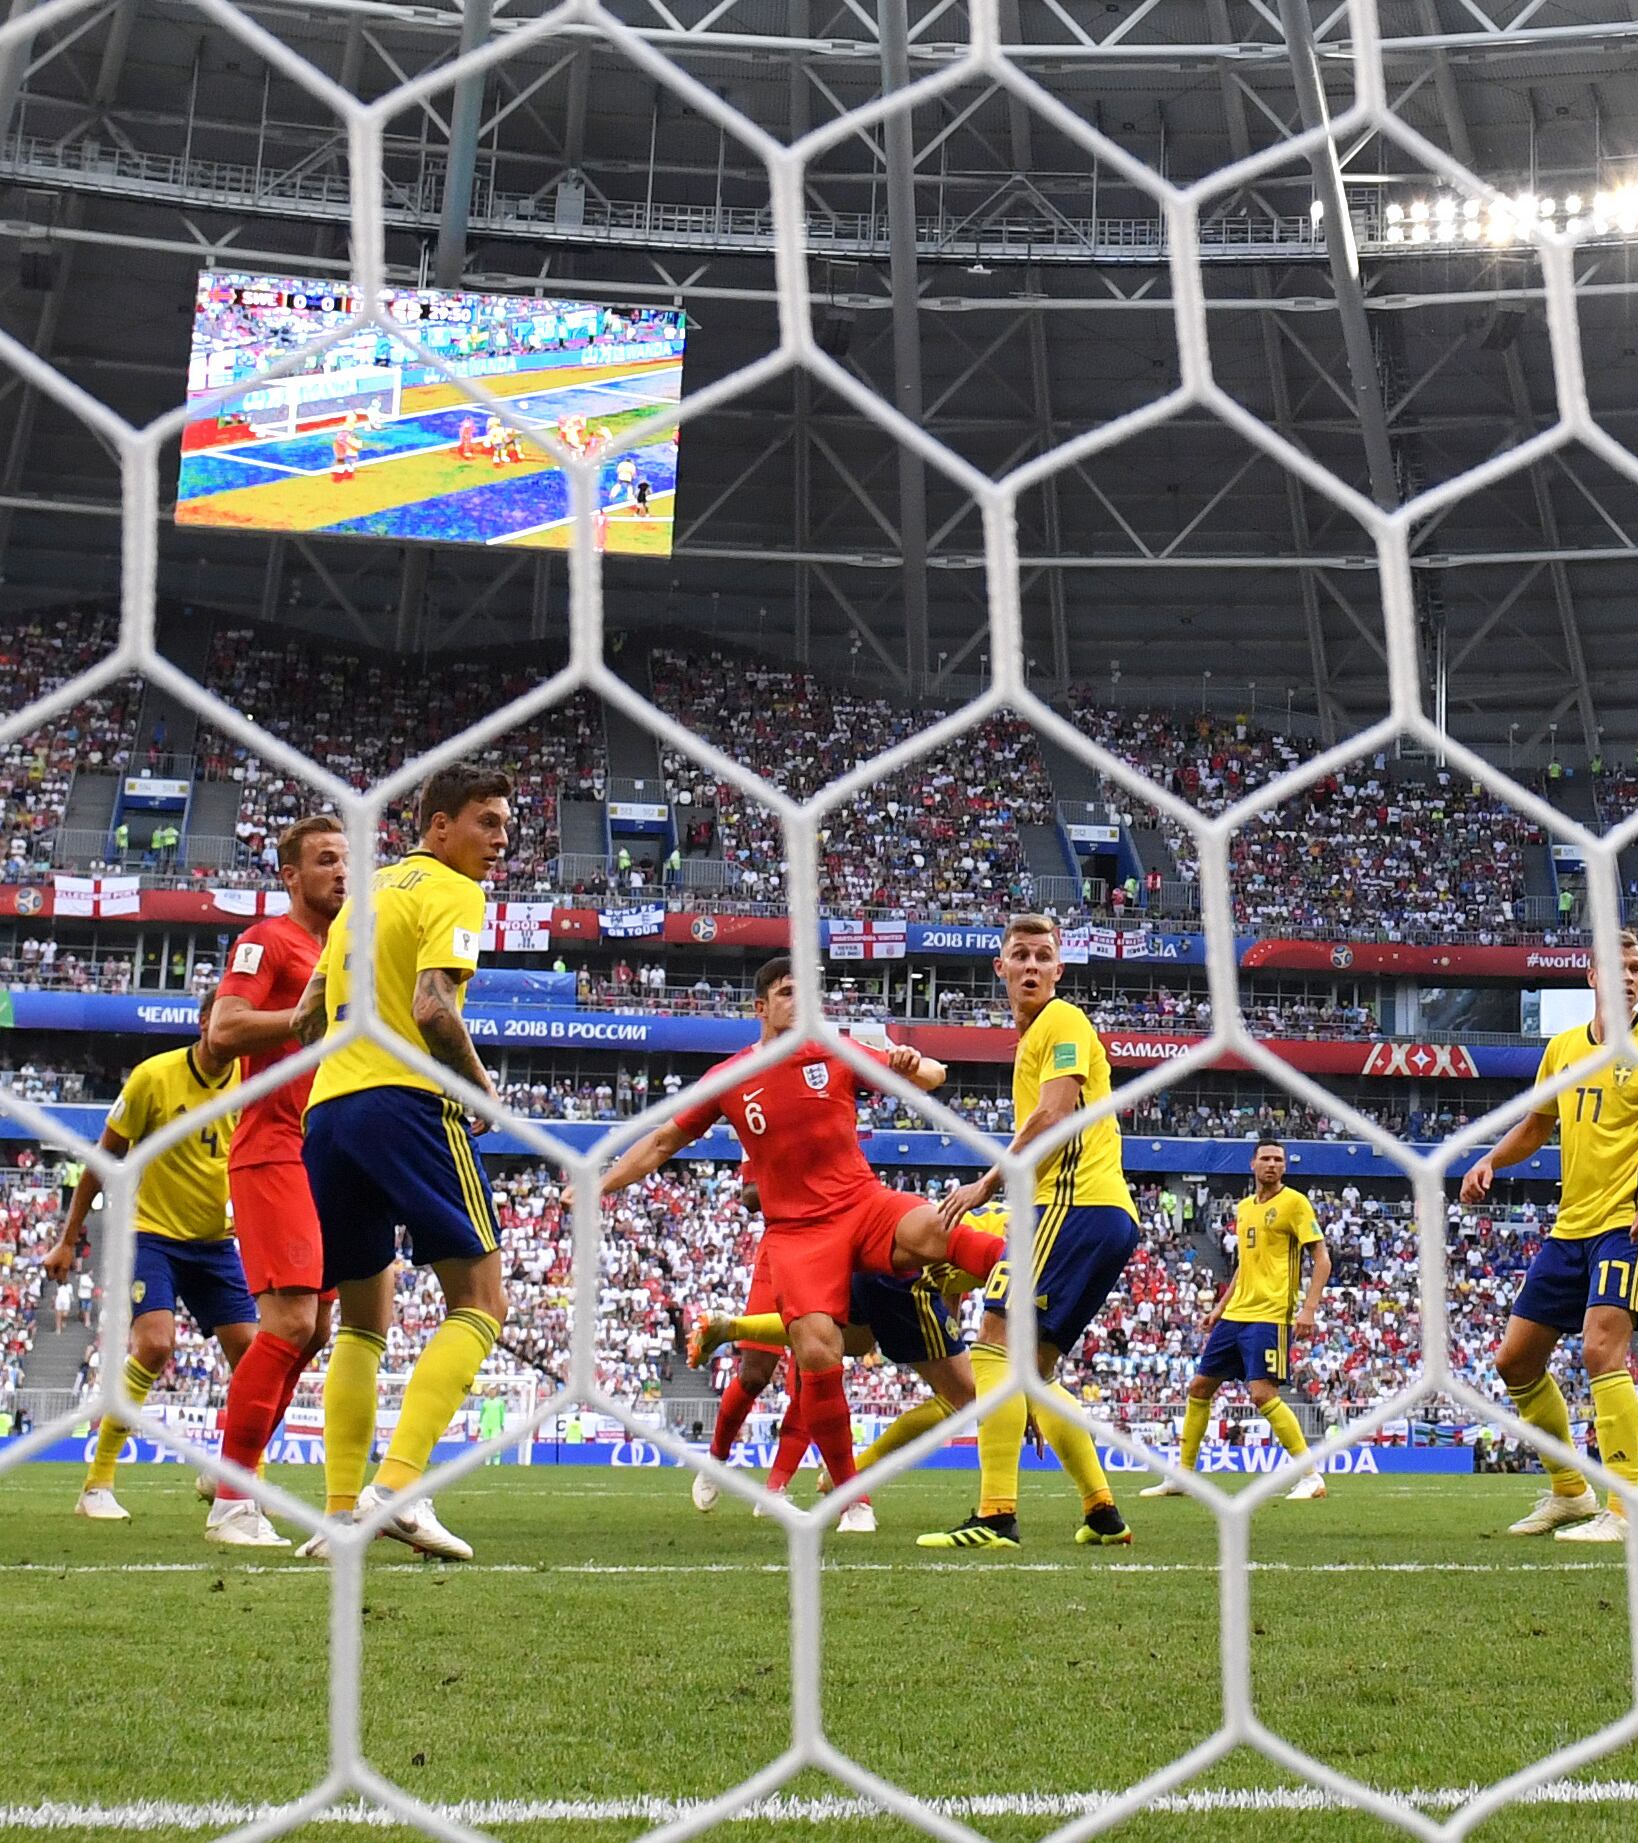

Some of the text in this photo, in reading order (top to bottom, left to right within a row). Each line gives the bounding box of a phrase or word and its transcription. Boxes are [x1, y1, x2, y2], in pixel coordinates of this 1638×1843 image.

[627, 924, 659, 937] TOUR
[922, 931, 963, 948] 2018
[965, 933, 1002, 950] FIFA
[1526, 951, 1591, 968] #world
[504, 1019, 547, 1038] 2018
[551, 1021, 564, 1038] В
[568, 1022, 648, 1041] РОССИИ
[1109, 1040, 1190, 1058] SAMARA
[1576, 1087, 1603, 1124] 17
[745, 1102, 767, 1135] 6
[201, 1127, 218, 1158] 4
[1246, 1226, 1256, 1249] 9
[1598, 1259, 1630, 1298] 17
[1264, 1349, 1277, 1373] 9
